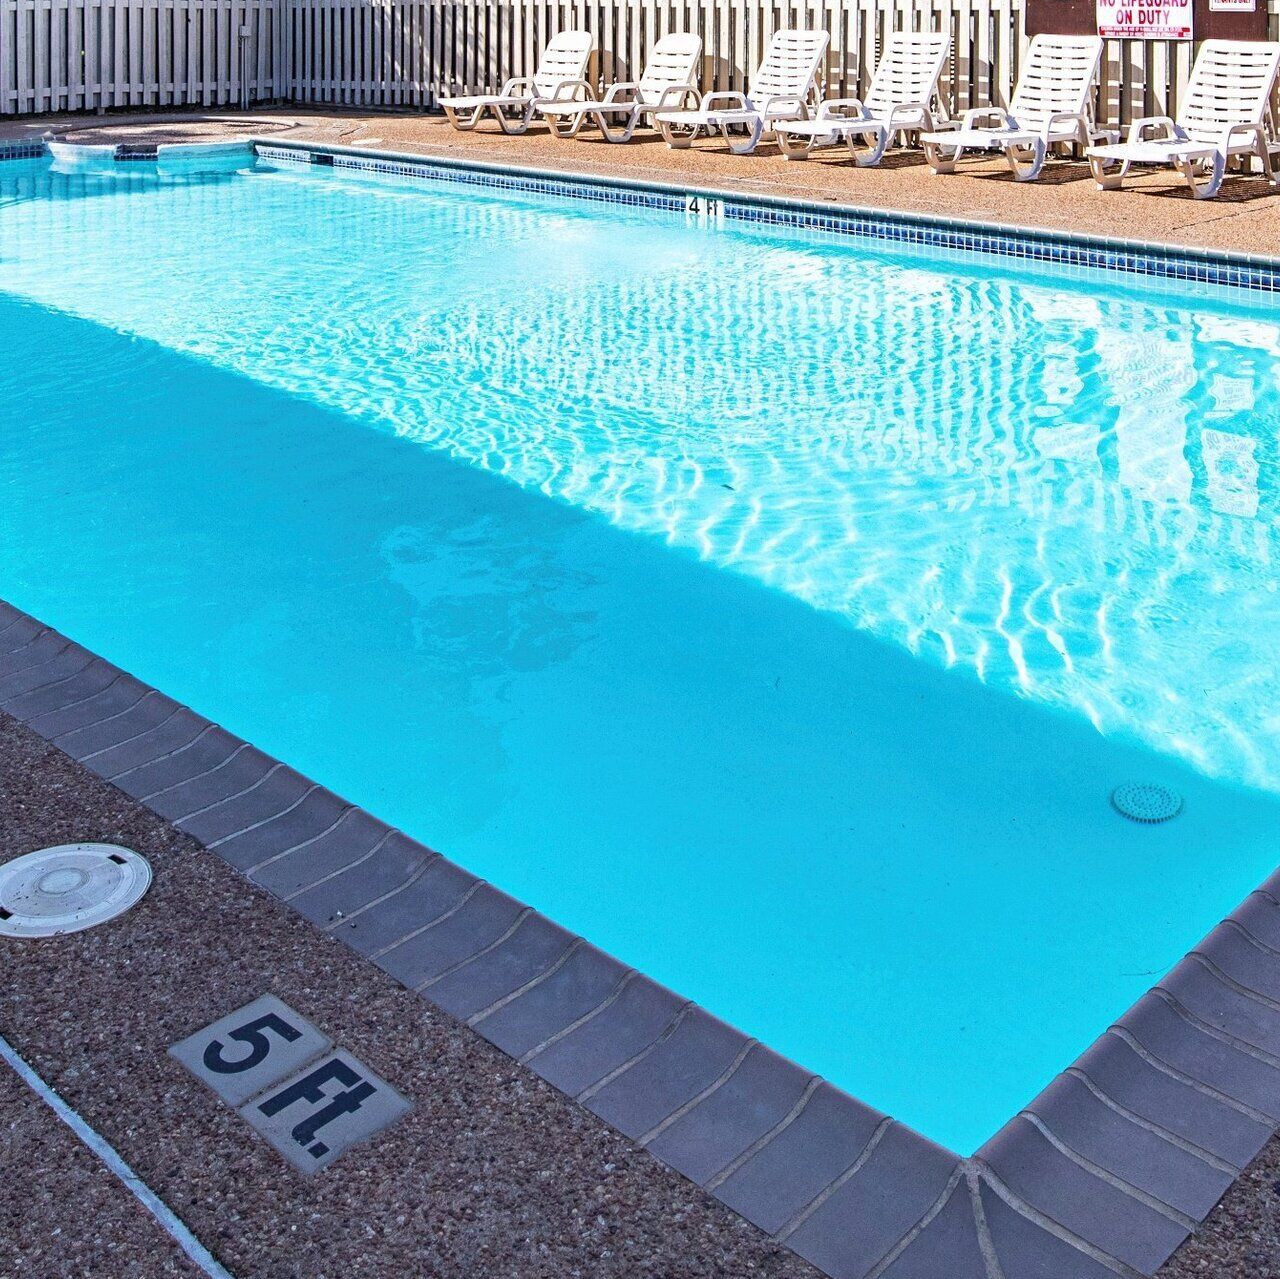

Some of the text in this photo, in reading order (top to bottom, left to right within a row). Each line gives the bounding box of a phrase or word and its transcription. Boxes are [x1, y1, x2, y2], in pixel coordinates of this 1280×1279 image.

[1116, 9, 1170, 25] ON DUTY
[689, 197, 700, 214] 4
[203, 1012, 303, 1074] 5
